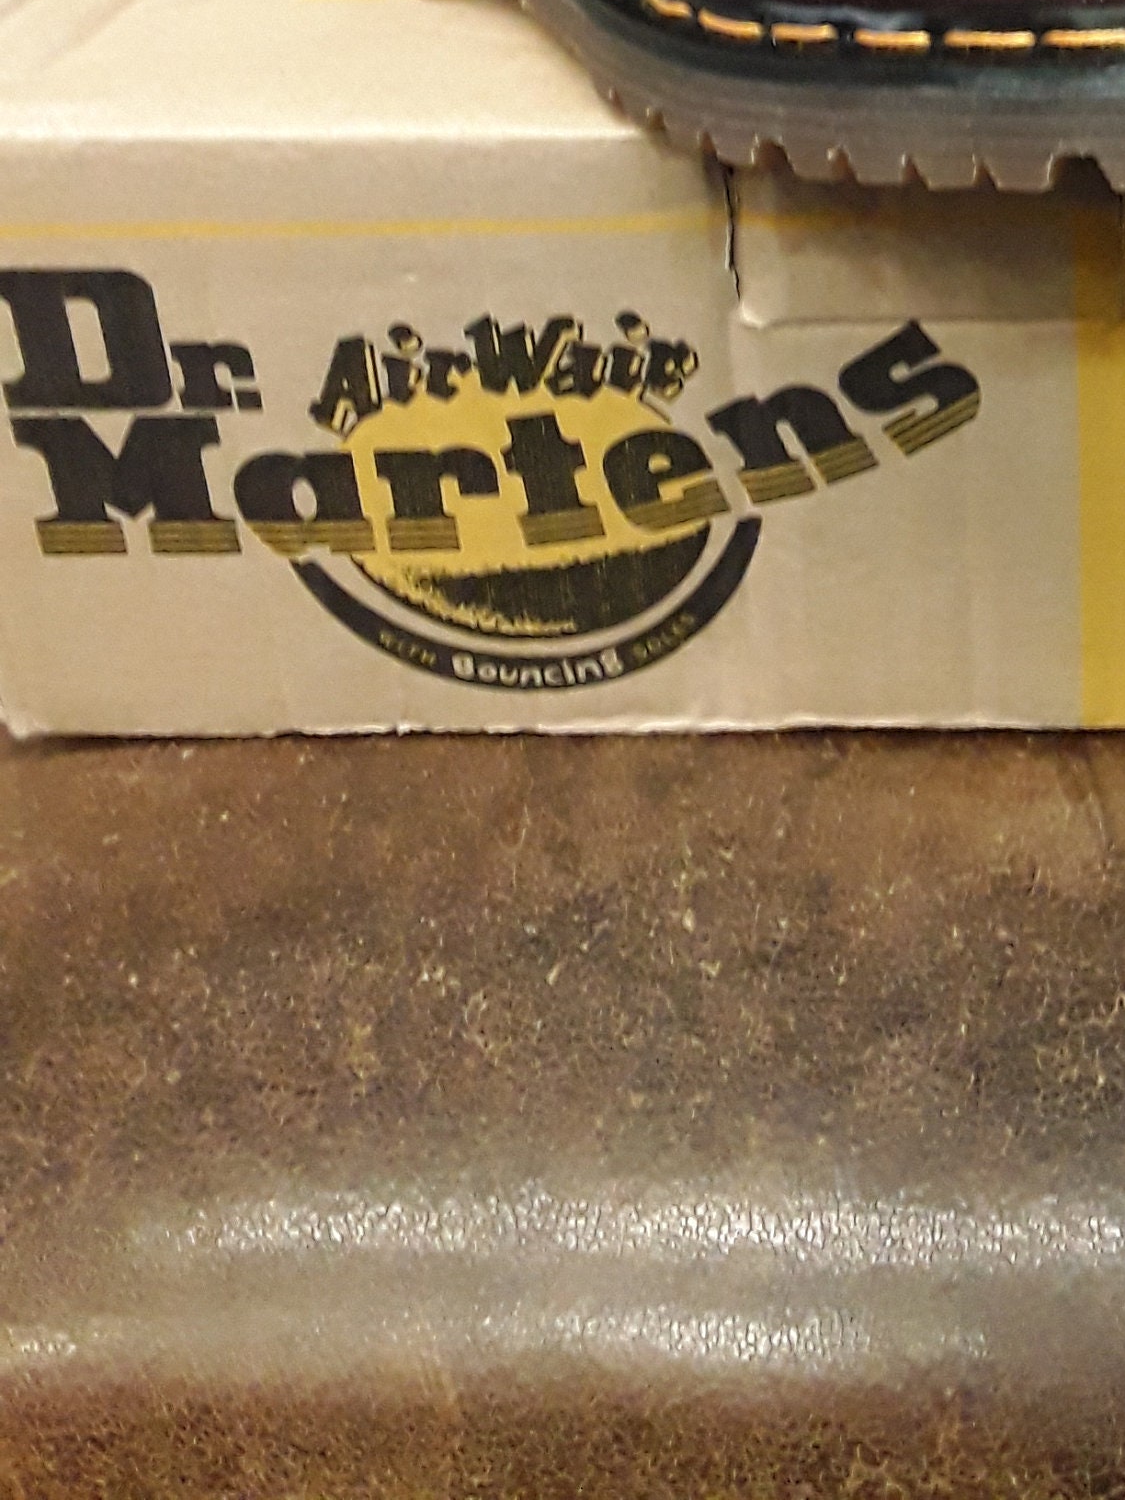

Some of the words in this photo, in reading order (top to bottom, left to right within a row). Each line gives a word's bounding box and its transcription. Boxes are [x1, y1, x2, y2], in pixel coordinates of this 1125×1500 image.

[0, 269, 263, 411] Dr.
[11, 319, 981, 561] Martens
[451, 645, 624, 687] Bouncing
